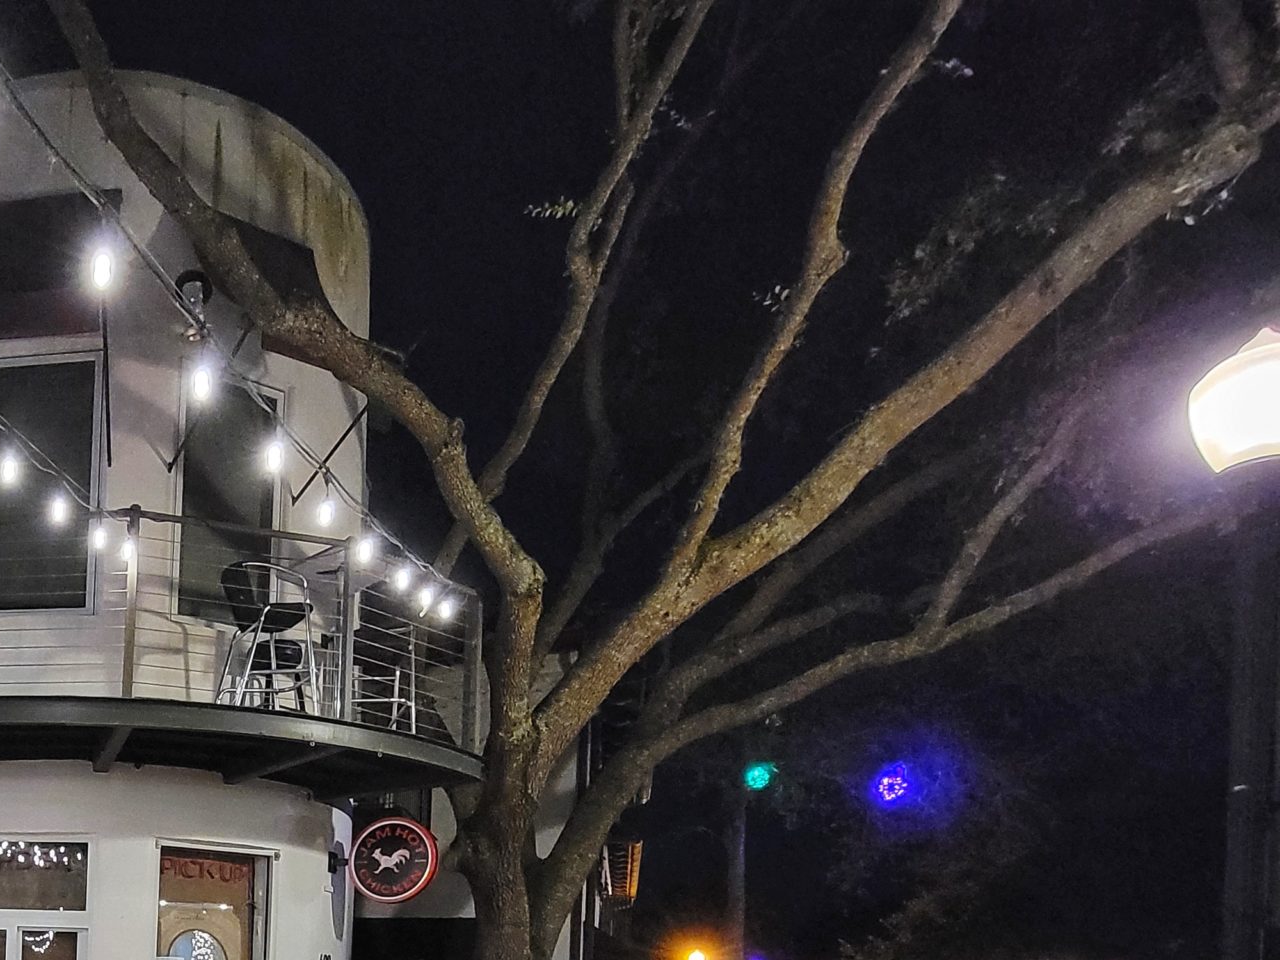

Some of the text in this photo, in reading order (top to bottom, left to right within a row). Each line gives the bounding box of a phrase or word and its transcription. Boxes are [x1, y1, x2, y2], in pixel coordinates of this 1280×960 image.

[360, 826, 426, 857] JAM HOT
[360, 867, 424, 894] CHICKEN
